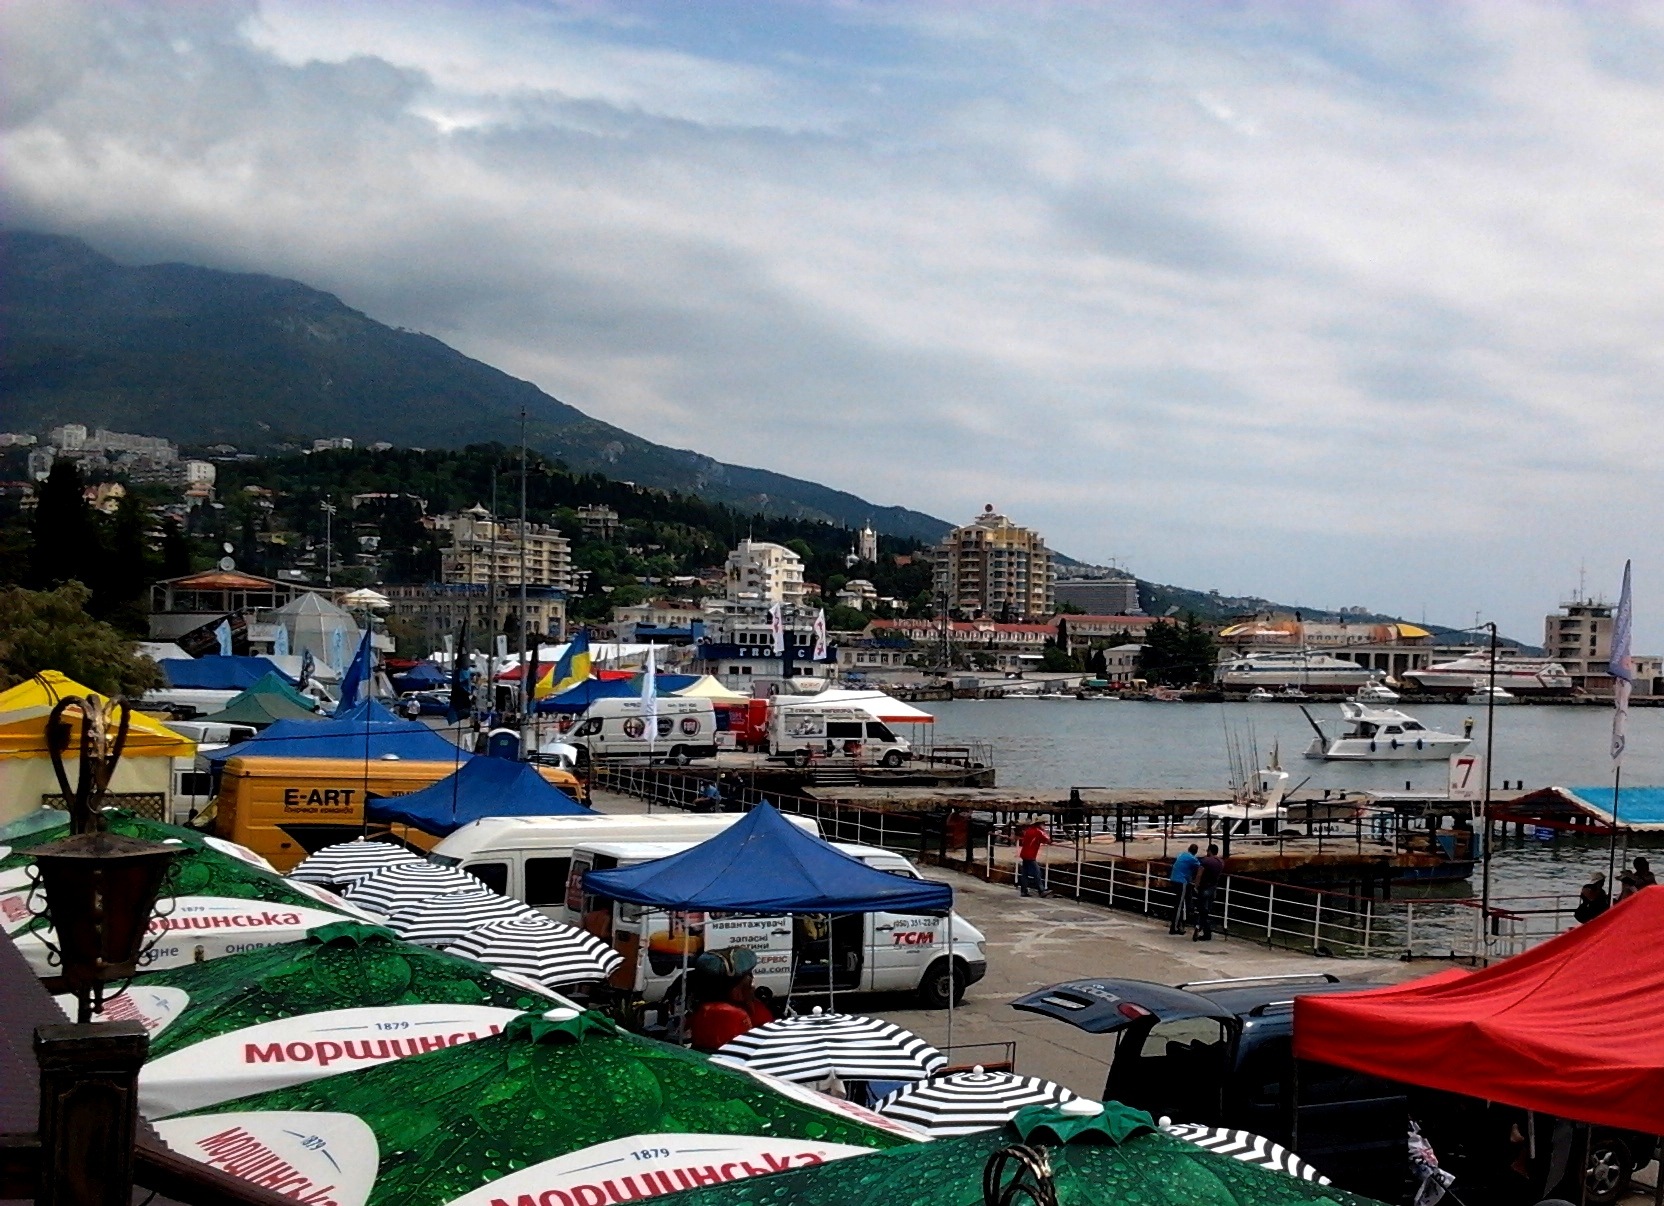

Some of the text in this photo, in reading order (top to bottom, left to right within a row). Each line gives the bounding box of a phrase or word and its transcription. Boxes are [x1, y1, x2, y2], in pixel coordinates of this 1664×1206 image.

[1455, 758, 1475, 789] 7
[284, 788, 356, 807] E-ART
[145, 911, 301, 936] ршинська
[374, 1021, 410, 1031] 1879
[630, 1147, 670, 1162] 1879
